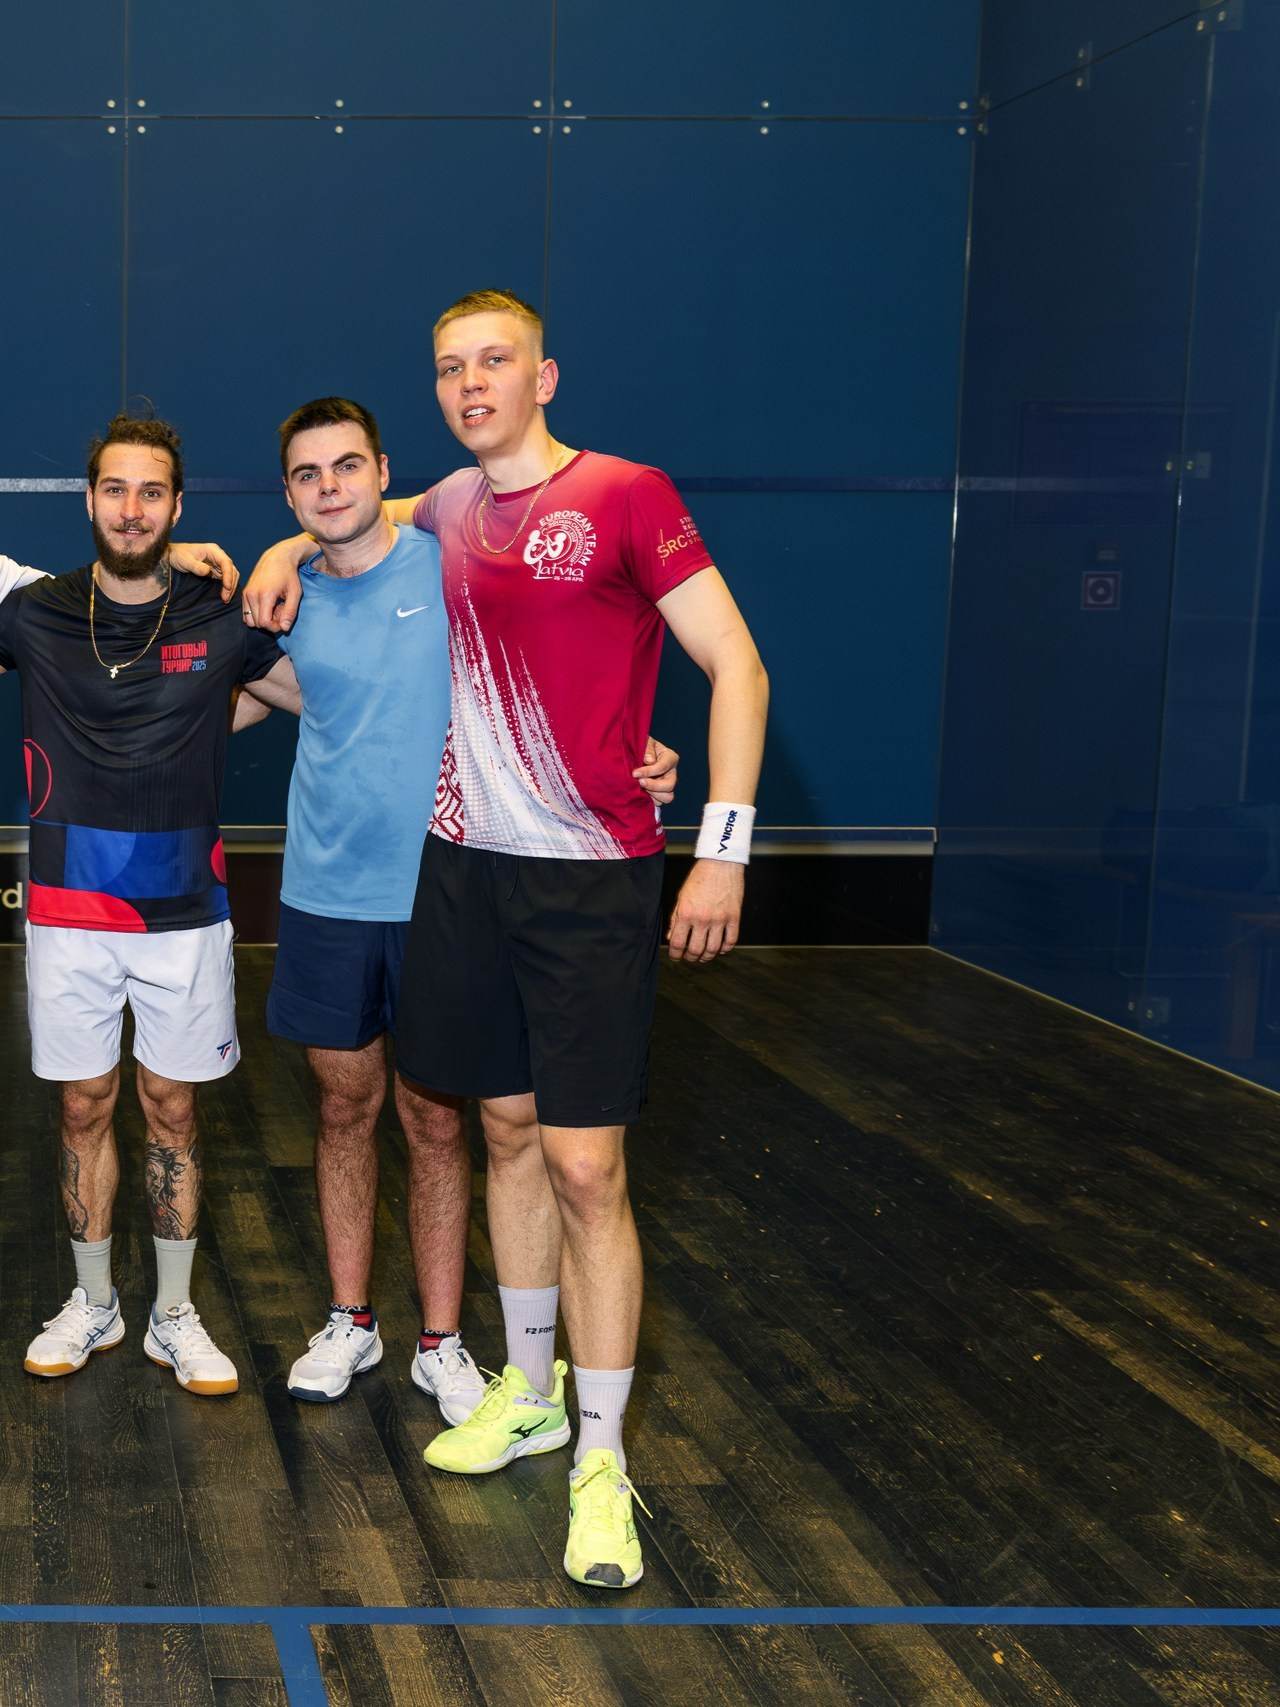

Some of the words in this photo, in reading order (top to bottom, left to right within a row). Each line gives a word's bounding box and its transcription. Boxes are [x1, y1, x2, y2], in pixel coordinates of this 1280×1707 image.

[539, 510, 594, 532] EUROPEAN
[578, 533, 597, 567] TEAM
[657, 535, 688, 559] SRC
[161, 640, 207, 660] ИТОГОВЫЙ
[161, 658, 192, 674] ТУРНИР
[191, 660, 207, 671] 2025
[720, 809, 738, 843] VICTOR
